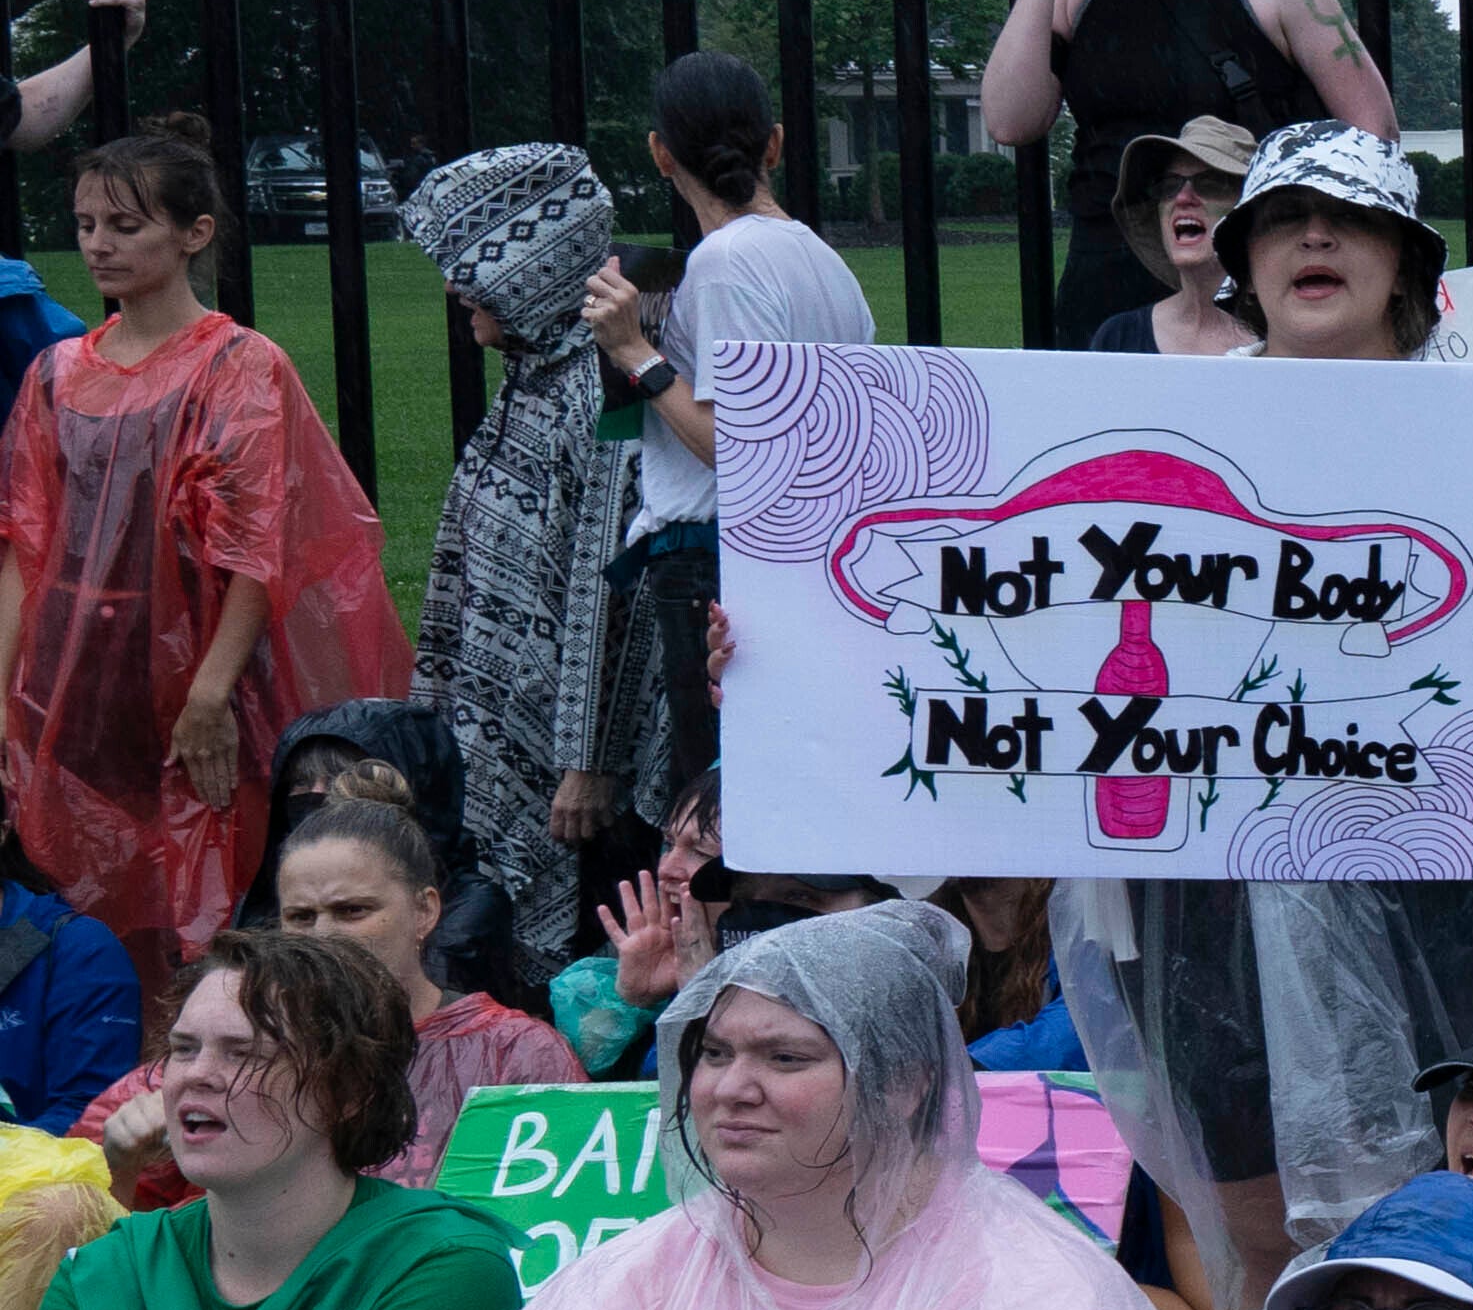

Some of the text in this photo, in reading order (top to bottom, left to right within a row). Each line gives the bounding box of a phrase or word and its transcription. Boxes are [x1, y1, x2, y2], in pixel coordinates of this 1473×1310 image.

[939, 522, 1405, 624] Not Your Body
[926, 695, 1419, 784] Not Your Choice
